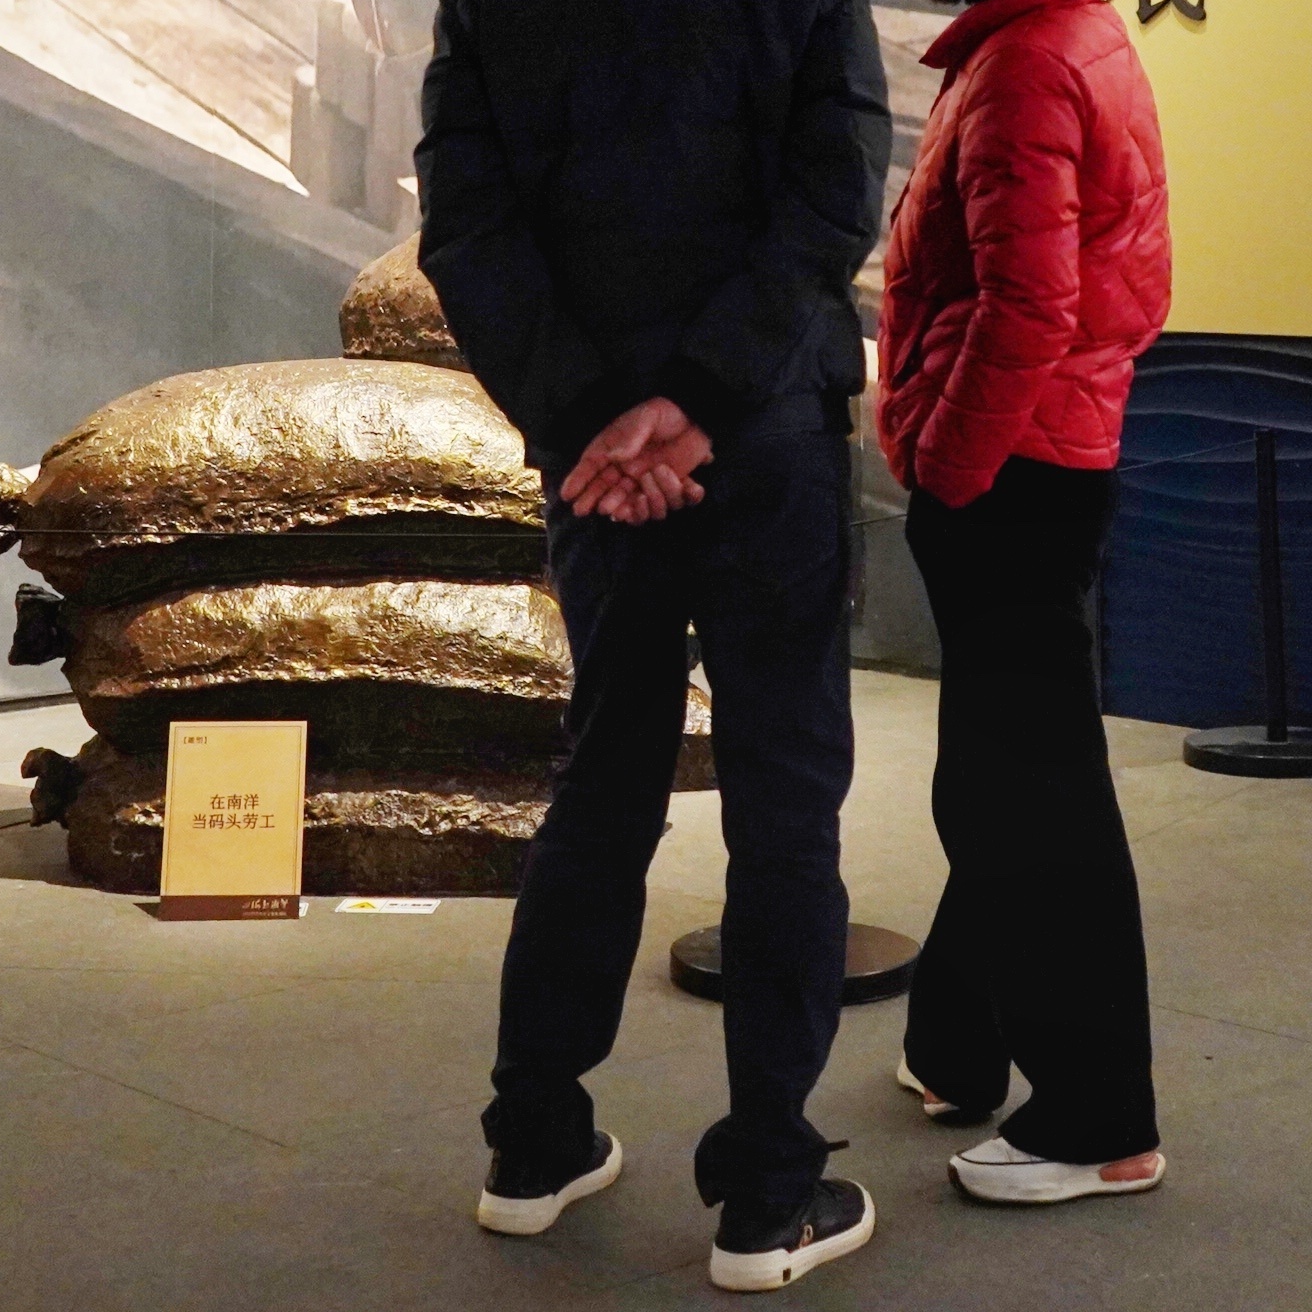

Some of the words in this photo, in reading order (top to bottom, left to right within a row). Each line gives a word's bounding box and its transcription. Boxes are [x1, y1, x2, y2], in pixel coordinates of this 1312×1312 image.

[210, 793, 260, 810] 在南洋
[192, 813, 275, 830] 当码头劳工
